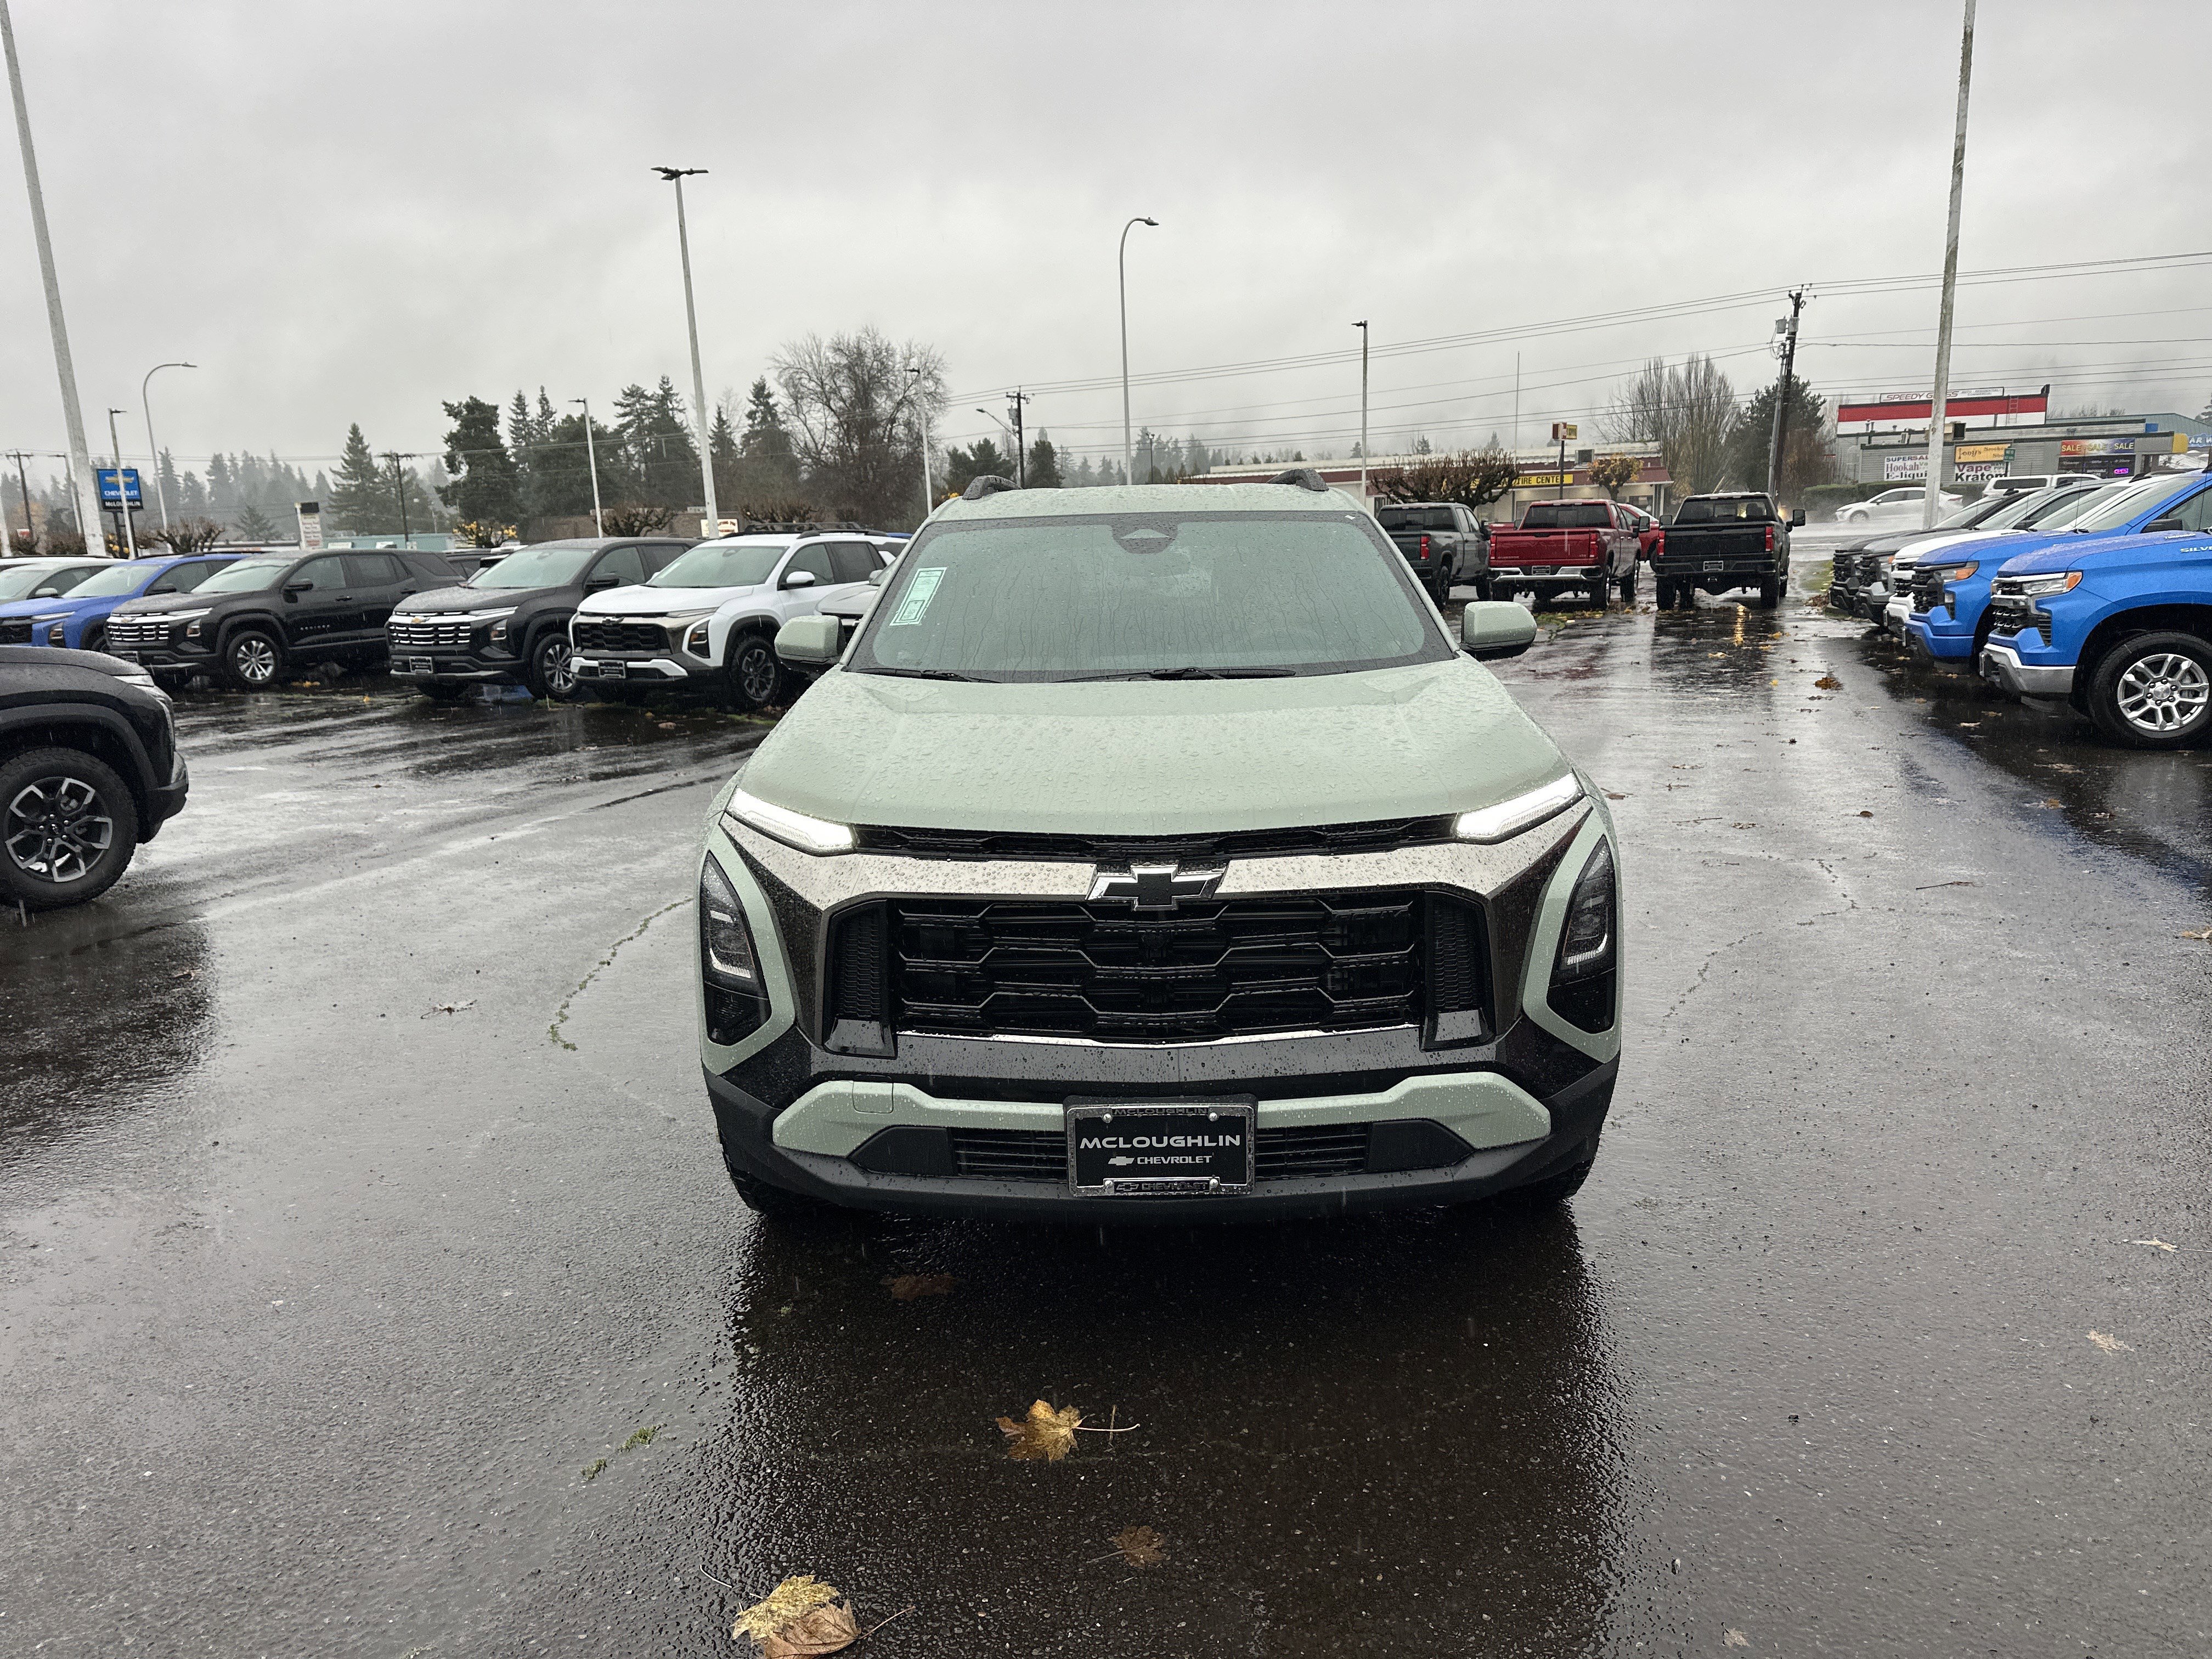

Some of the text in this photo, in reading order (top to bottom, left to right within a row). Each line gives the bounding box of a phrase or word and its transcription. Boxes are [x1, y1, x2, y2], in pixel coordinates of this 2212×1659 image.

[1883, 391, 1960, 401] SPEEDY GSS
[2086, 443, 2108, 452] SALE
[1886, 462, 1919, 472] Hookah
[1956, 464, 1991, 473] Vape
[1886, 471, 1927, 479] E-liqui
[1536, 476, 1565, 484] CENTE
[1114, 1107, 1209, 1115] MCLOUGHLIN
[1080, 1135, 1240, 1149] MCLOUGHLIN
[1137, 1155, 1212, 1165] CHEVROLET
[1141, 1181, 1208, 1191] CHEVROLET
